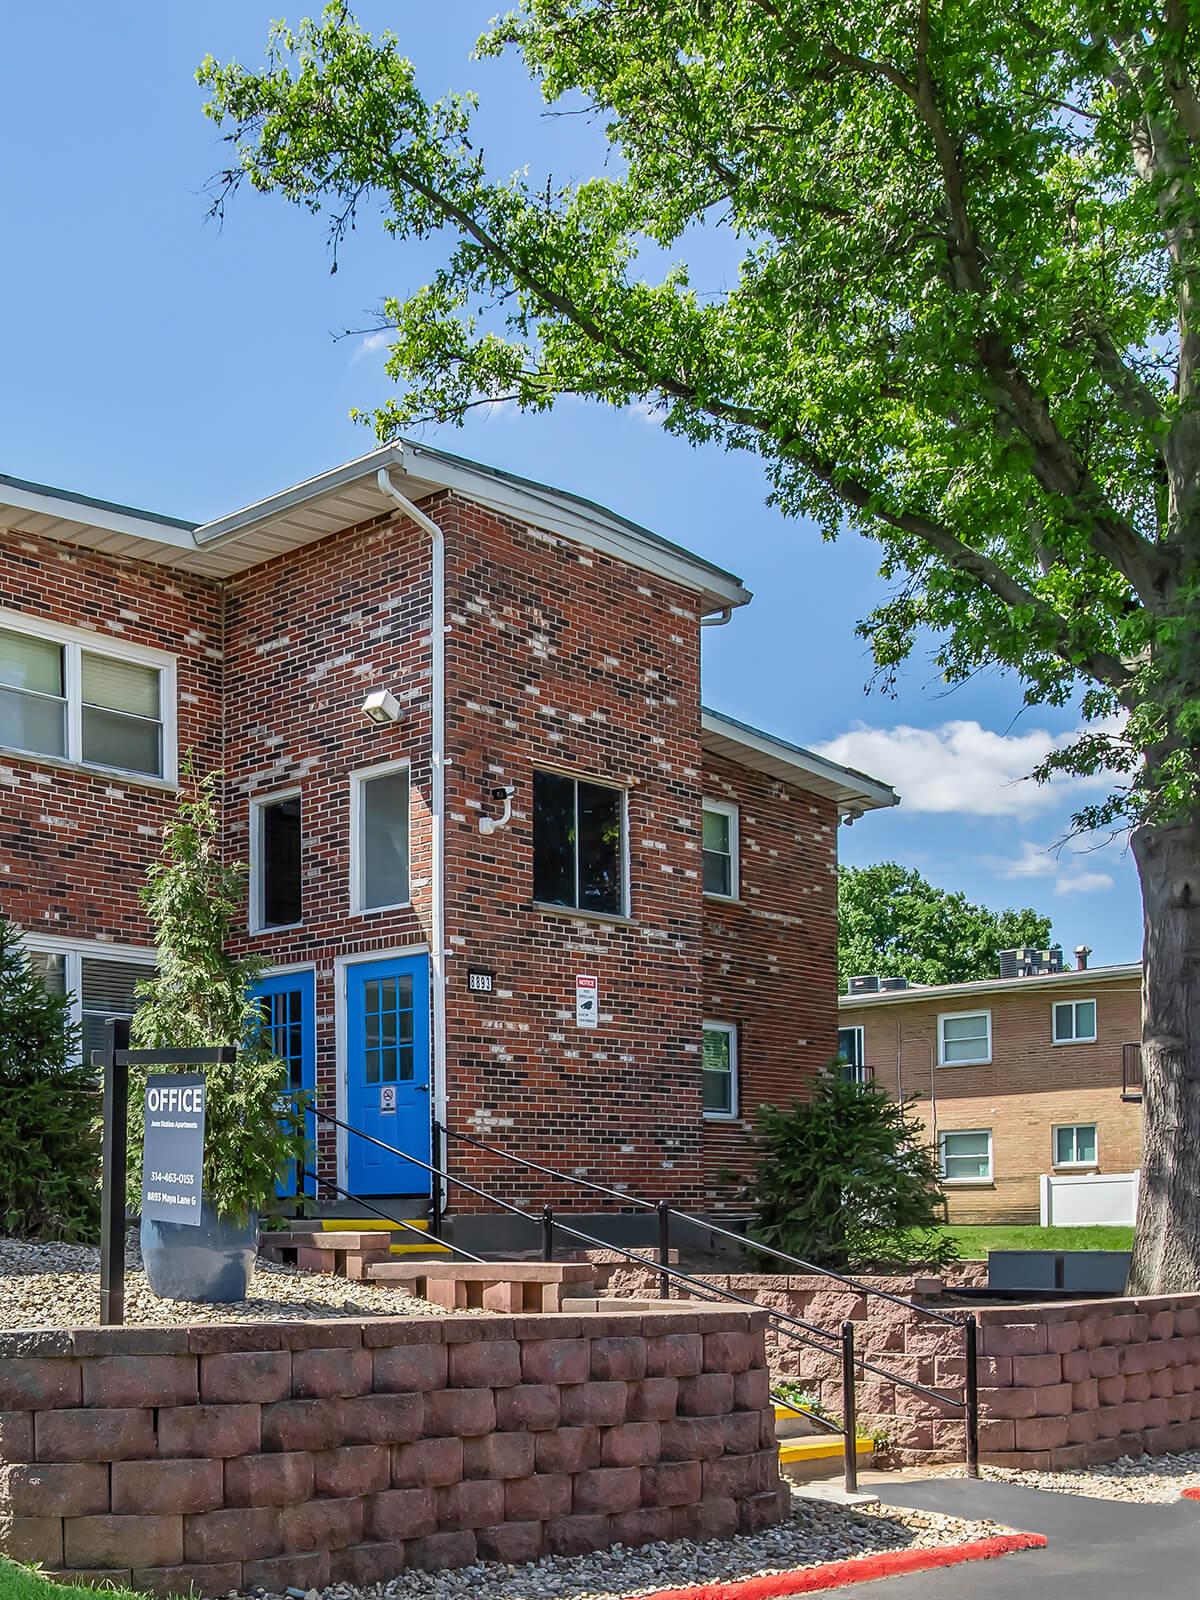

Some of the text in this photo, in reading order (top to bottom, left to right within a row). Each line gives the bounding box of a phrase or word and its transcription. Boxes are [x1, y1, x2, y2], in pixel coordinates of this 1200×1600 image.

[471, 975, 490, 990] 8893
[148, 1088, 202, 1112] OFFICE
[146, 1191, 197, 1206] 8893 Maya Lane G
